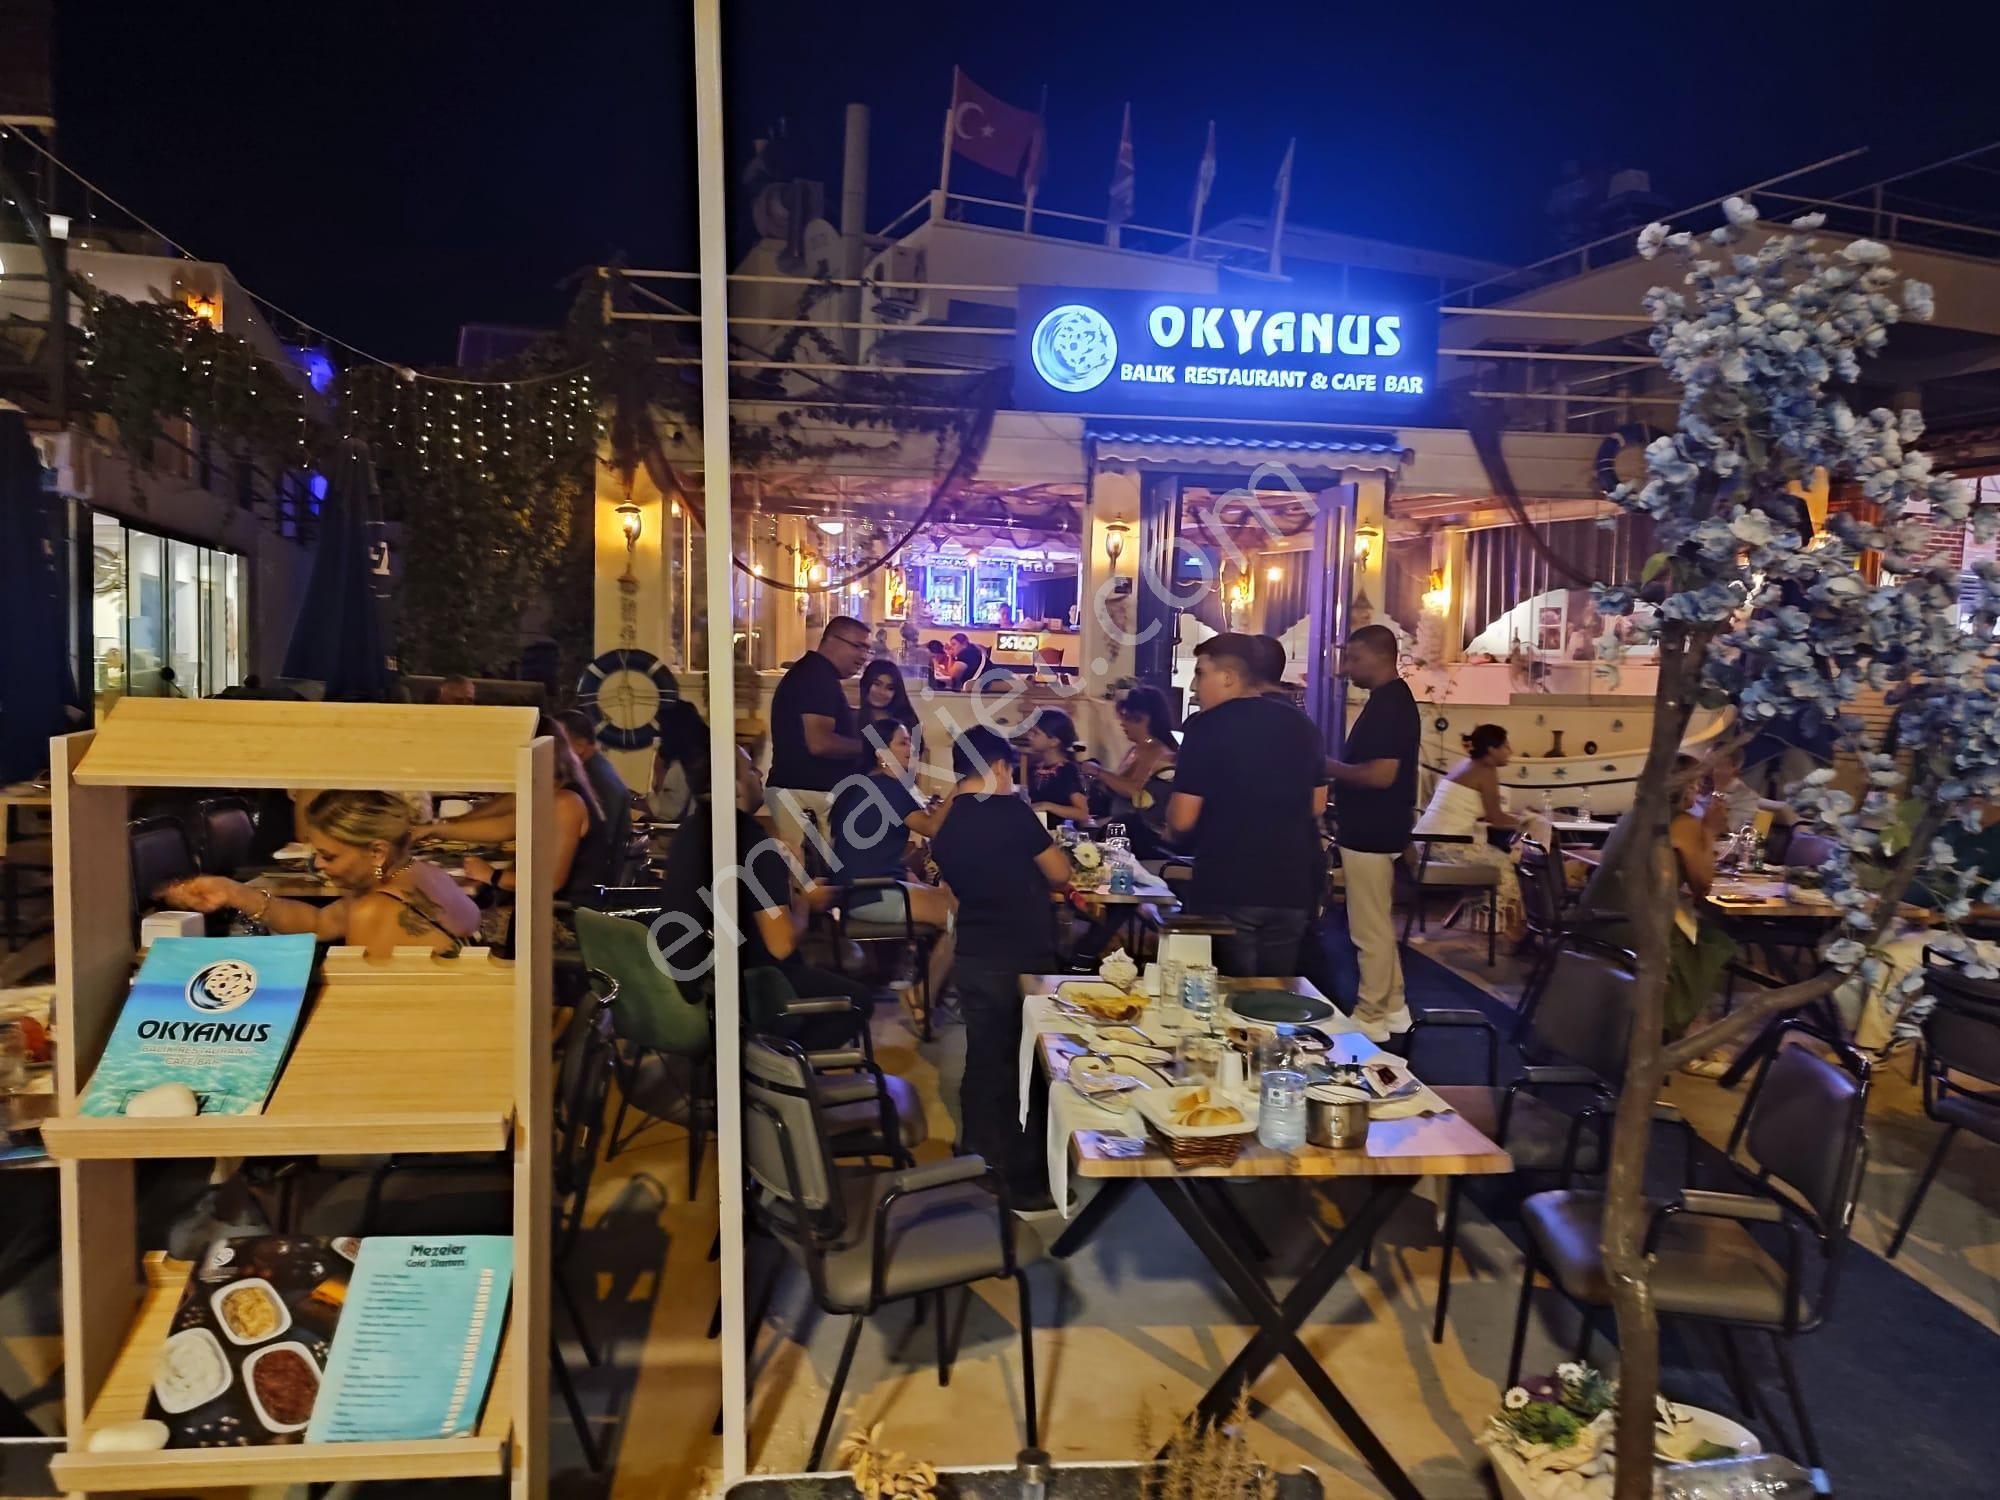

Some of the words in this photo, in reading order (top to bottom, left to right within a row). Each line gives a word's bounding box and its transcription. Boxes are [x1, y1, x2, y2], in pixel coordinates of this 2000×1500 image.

[1149, 305, 1401, 356] OKYANUS
[1120, 363, 1175, 384] BALIK
[1184, 366, 1307, 388] RESTAURANT
[1310, 372, 1328, 390] &
[1331, 373, 1377, 391] CAFE
[1384, 375, 1424, 394] BAR
[137, 1020, 272, 1043] OKYANUS
